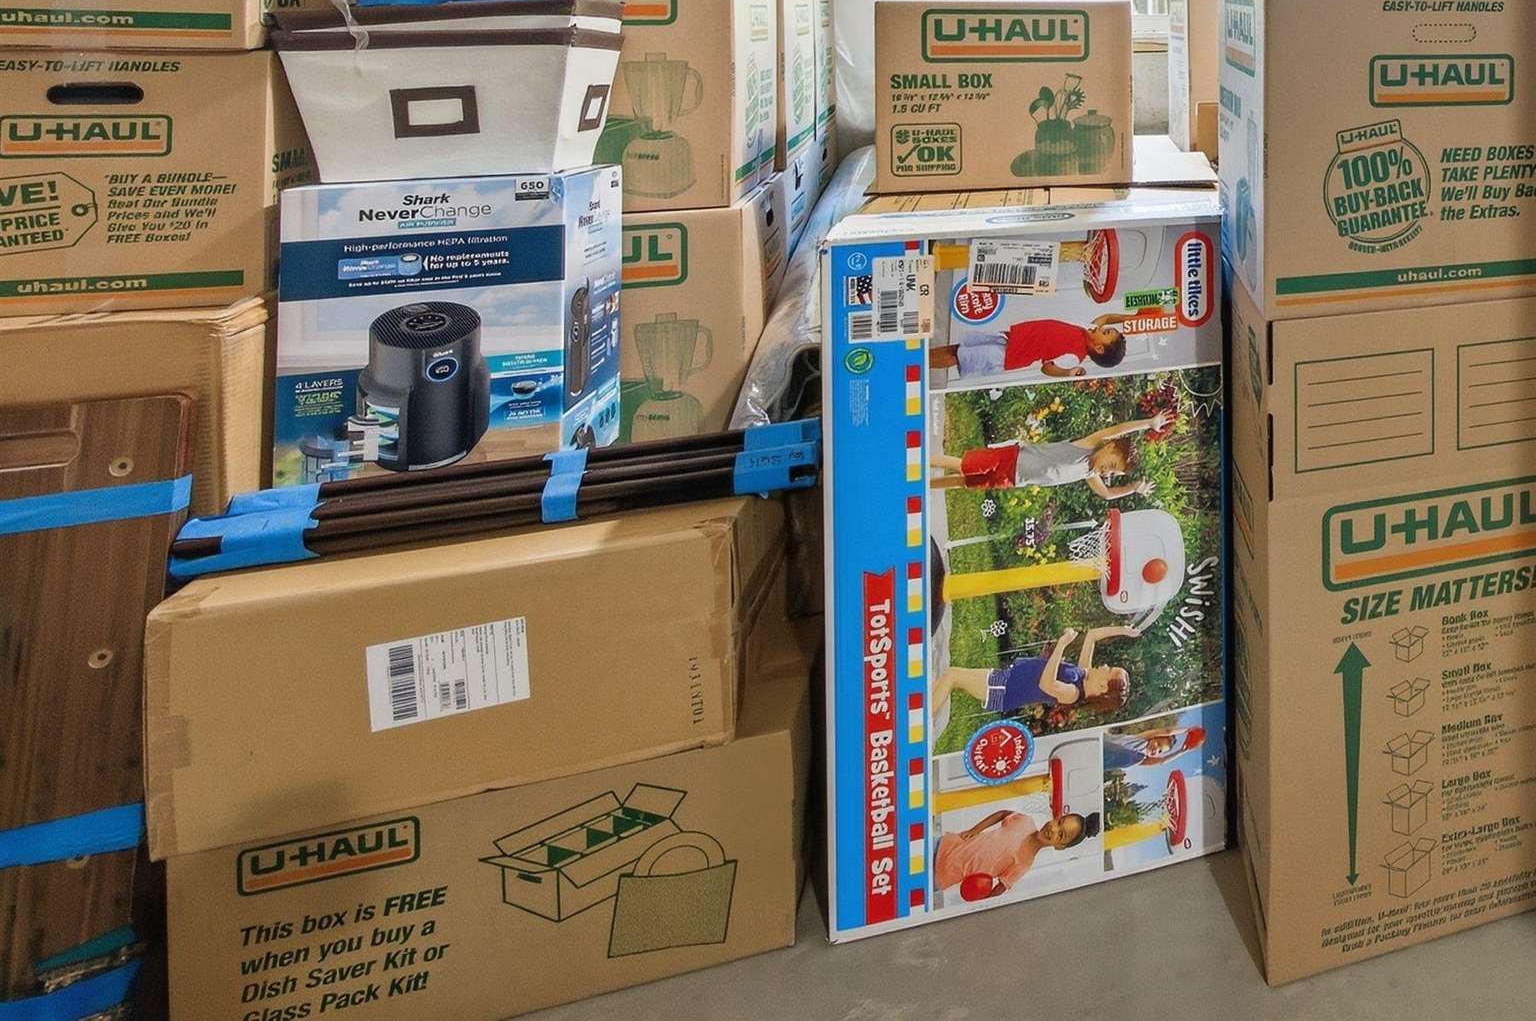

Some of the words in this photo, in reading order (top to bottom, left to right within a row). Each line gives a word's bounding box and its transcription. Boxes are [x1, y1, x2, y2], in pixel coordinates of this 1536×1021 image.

[1383, 1, 1454, 12] EASY-TO-LIFT
[1457, 1, 1504, 12] HANDLES
[1, 11, 133, 24] uhaul.com
[934, 19, 1078, 41] U-HAUL
[109, 61, 180, 72] HANDLES
[890, 74, 951, 89] SMALL
[959, 74, 992, 88] BOX
[1381, 65, 1504, 86] U-HAUL
[911, 104, 925, 112] CU
[928, 104, 941, 112] FT
[9, 122, 160, 141] U-HAUL
[1341, 124, 1398, 144] U-HAUL
[917, 146, 955, 162] OK
[1440, 147, 1481, 163] NEED
[1337, 147, 1413, 190] 100%
[1441, 167, 1478, 182] TAKE
[141, 173, 152, 183] A
[108, 186, 145, 197] SAVE
[149, 185, 188, 196] EVEN
[403, 193, 451, 205] Shark
[1334, 178, 1424, 216] BUY-BACK
[1440, 186, 1477, 202] We'll
[1483, 187, 1510, 201] Buy
[153, 209, 180, 219] and
[359, 204, 492, 222] NeverChange
[1337, 201, 1428, 237] GUARANTEE
[1440, 206, 1465, 220] the
[1470, 205, 1520, 220] Extras.
[0, 213, 60, 231] PRICE
[142, 221, 165, 231] You
[107, 234, 141, 243] FREE
[344, 240, 435, 252] High-performance
[437, 237, 465, 246] HEPA
[430, 254, 443, 262] No
[445, 261, 458, 269] up
[1188, 242, 1203, 278] little
[1398, 266, 1482, 282] uhaul.com
[18, 279, 146, 293] uhaul.com
[1188, 281, 1202, 317] tikes
[1341, 590, 1403, 624] SIZE
[1442, 666, 1470, 679] Small
[1473, 770, 1491, 780] Box
[870, 729, 896, 850] Basketball
[249, 826, 410, 876] U-HAUL
[871, 856, 892, 895] Set
[241, 921, 293, 946] This
[301, 910, 348, 934] box
[354, 903, 376, 923] is
[383, 885, 448, 916] FREE
[241, 947, 310, 975] when
[318, 936, 363, 963] you
[371, 924, 415, 947] buy
[421, 920, 436, 936] a
[241, 976, 297, 1004] Dish
[306, 959, 377, 988] Saver
[383, 947, 416, 971] Kit
[423, 944, 449, 962] or
[320, 983, 381, 1013] Pack
[389, 971, 429, 997] Kit!
